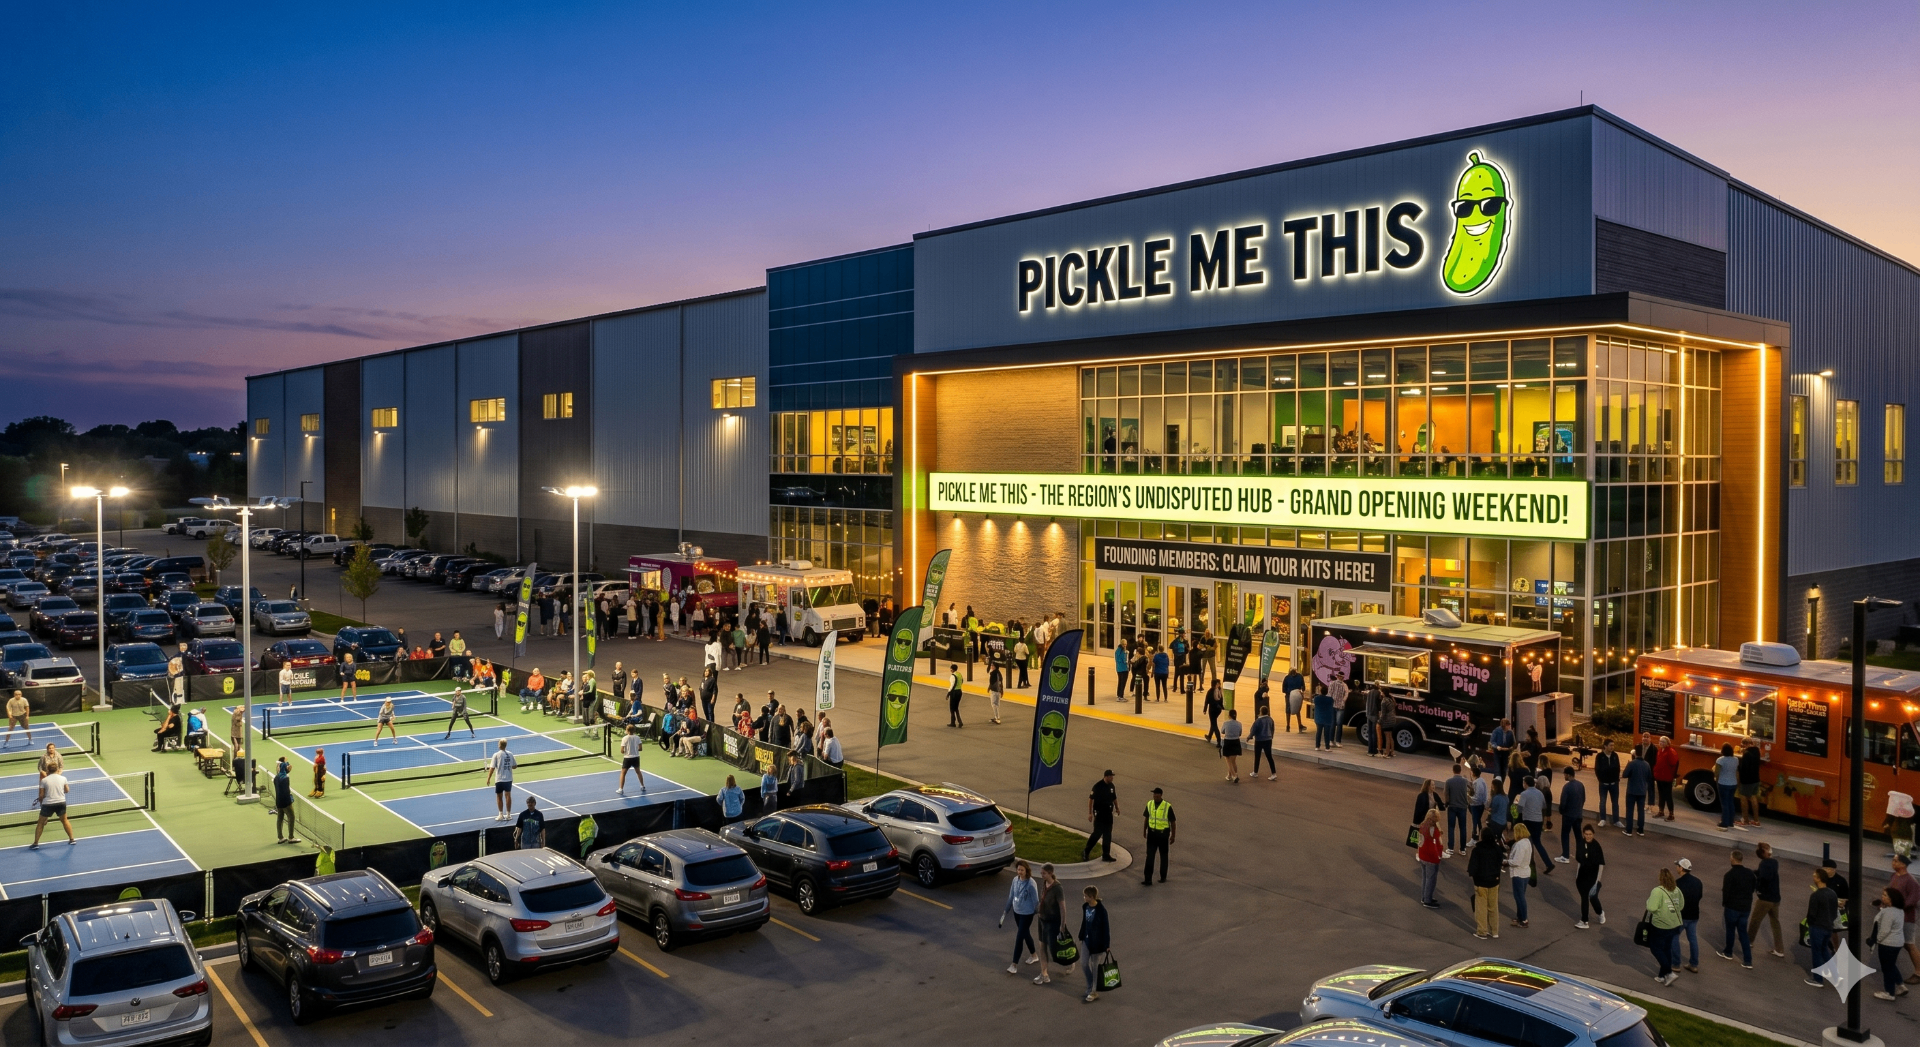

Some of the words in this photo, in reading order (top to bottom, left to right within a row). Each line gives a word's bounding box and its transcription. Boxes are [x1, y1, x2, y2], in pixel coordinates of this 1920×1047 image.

[1018, 238, 1172, 312] PICKLE
[1190, 223, 1265, 292] ME
[1283, 201, 1425, 281] THIS
[938, 481, 977, 503] PICKLE
[979, 482, 998, 504] ME
[1000, 483, 1028, 505] THIS
[1040, 484, 1065, 506] THE
[1068, 484, 1131, 509] REGION'S
[1135, 486, 1233, 512] UNDISPUTED
[1238, 487, 1272, 513] HUB
[1290, 488, 1352, 516] GRAND
[1358, 490, 1446, 520] OPENING
[1453, 492, 1569, 525] WEEKEND!
[1103, 545, 1156, 567] FOUNDING
[1158, 549, 1220, 572] MEMBERS:
[1222, 553, 1261, 575] CLAIM
[1263, 556, 1298, 578] YOUR
[1301, 559, 1331, 580] KITS
[1334, 560, 1375, 583] HERE!
